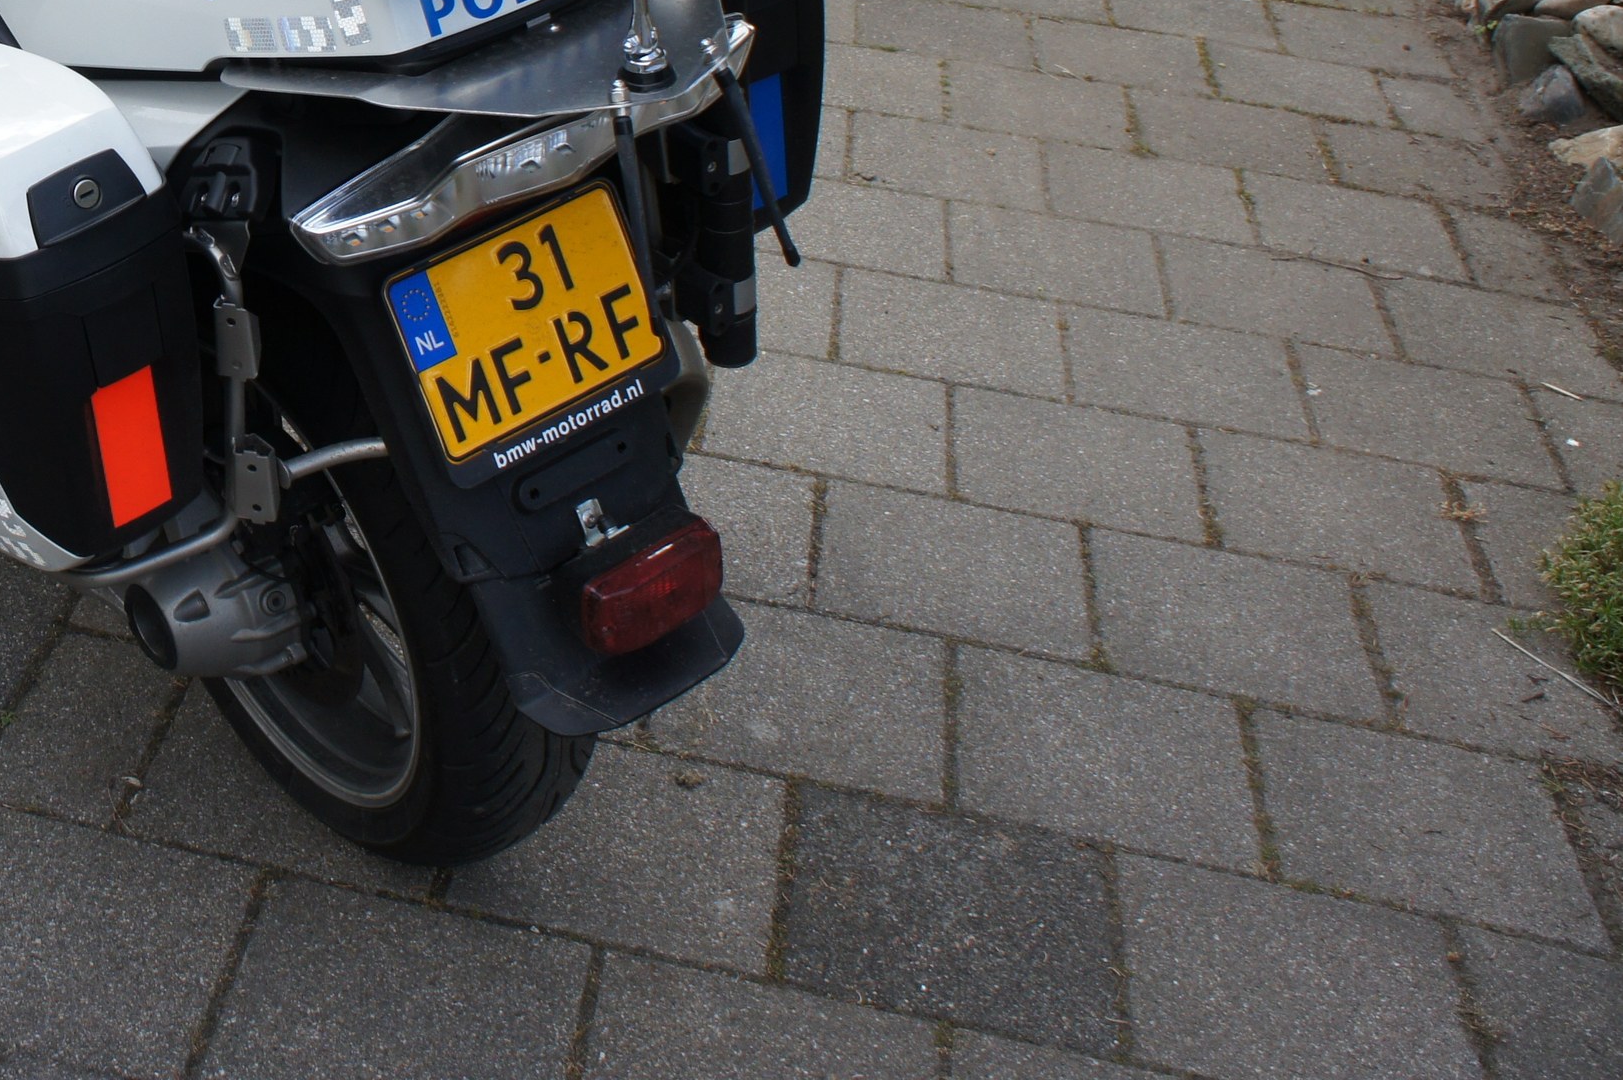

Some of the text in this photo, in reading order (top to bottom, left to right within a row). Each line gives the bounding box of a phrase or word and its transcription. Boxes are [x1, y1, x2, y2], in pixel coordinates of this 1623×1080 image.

[495, 223, 575, 311] 31
[414, 330, 445, 356] NL
[434, 283, 640, 444] MF-RF
[493, 379, 645, 469] bmw-motorrad.nl
